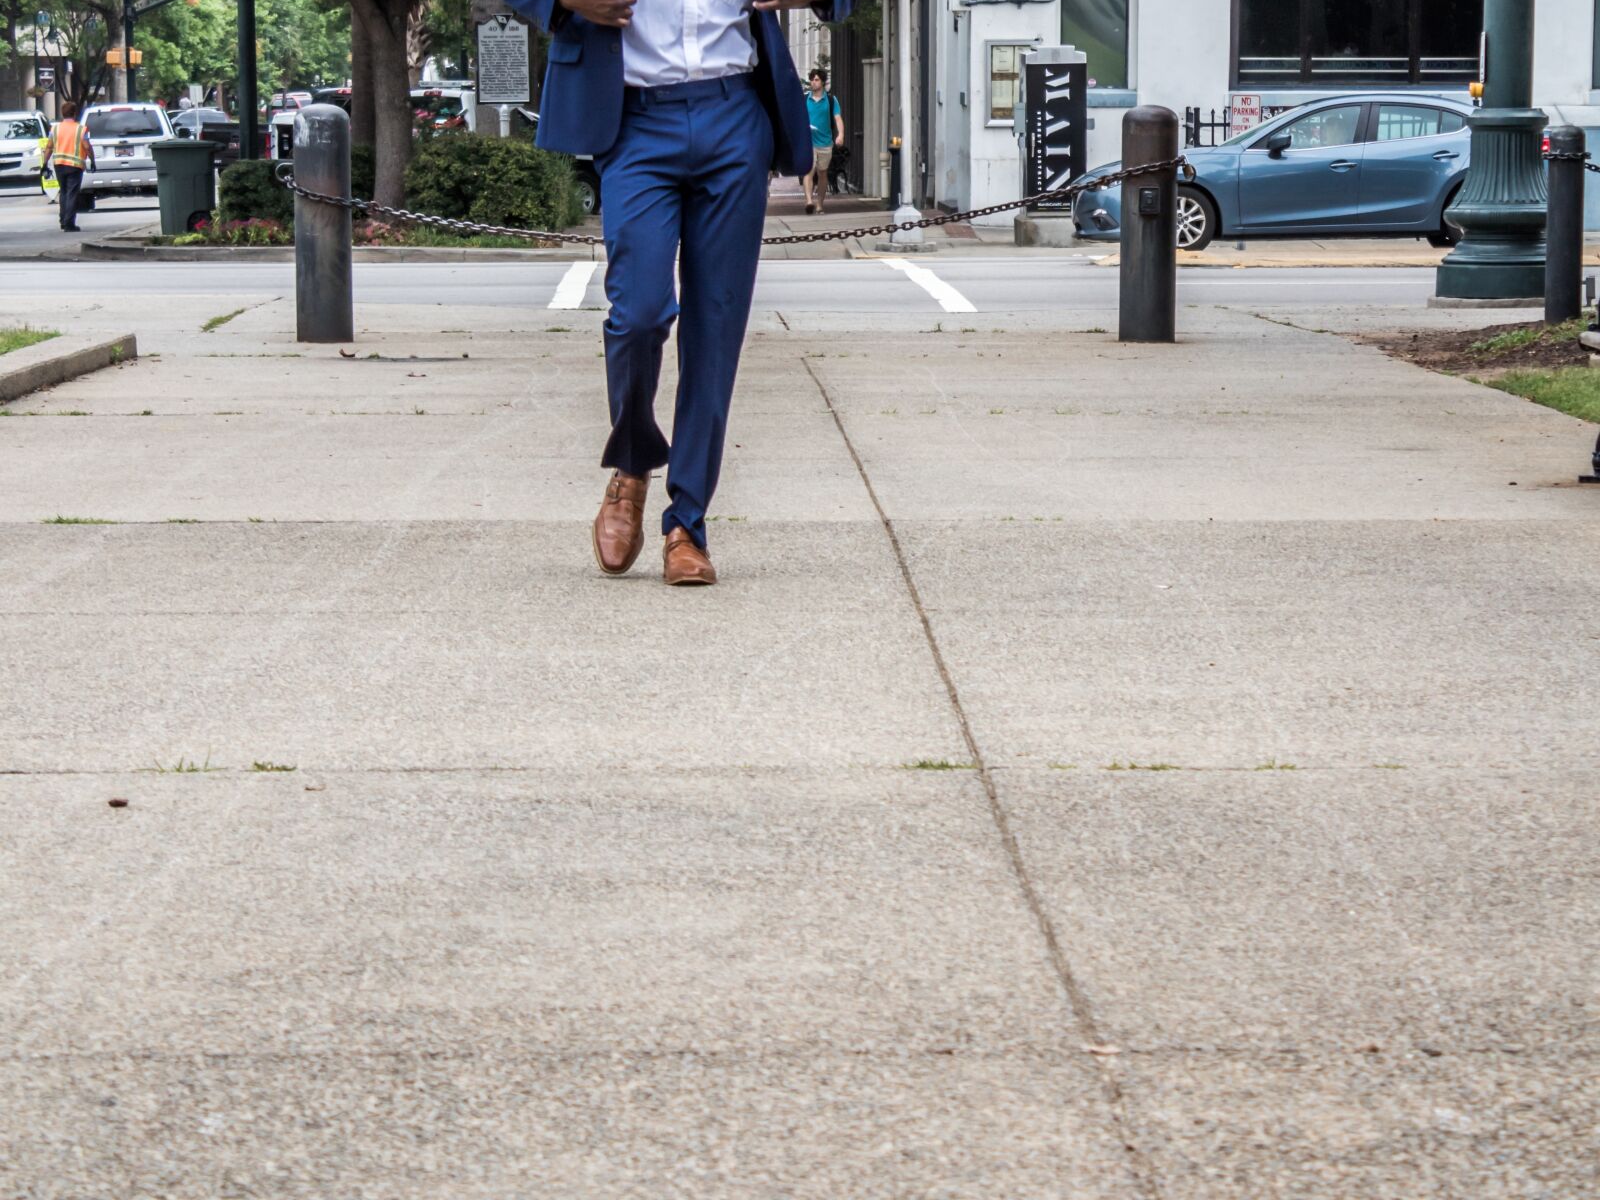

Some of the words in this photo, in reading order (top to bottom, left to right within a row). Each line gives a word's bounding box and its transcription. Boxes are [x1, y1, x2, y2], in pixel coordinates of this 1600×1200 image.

[1242, 97, 1252, 106] NO
[1234, 108, 1258, 116] PARKING
[1045, 68, 1070, 191] MAIN
